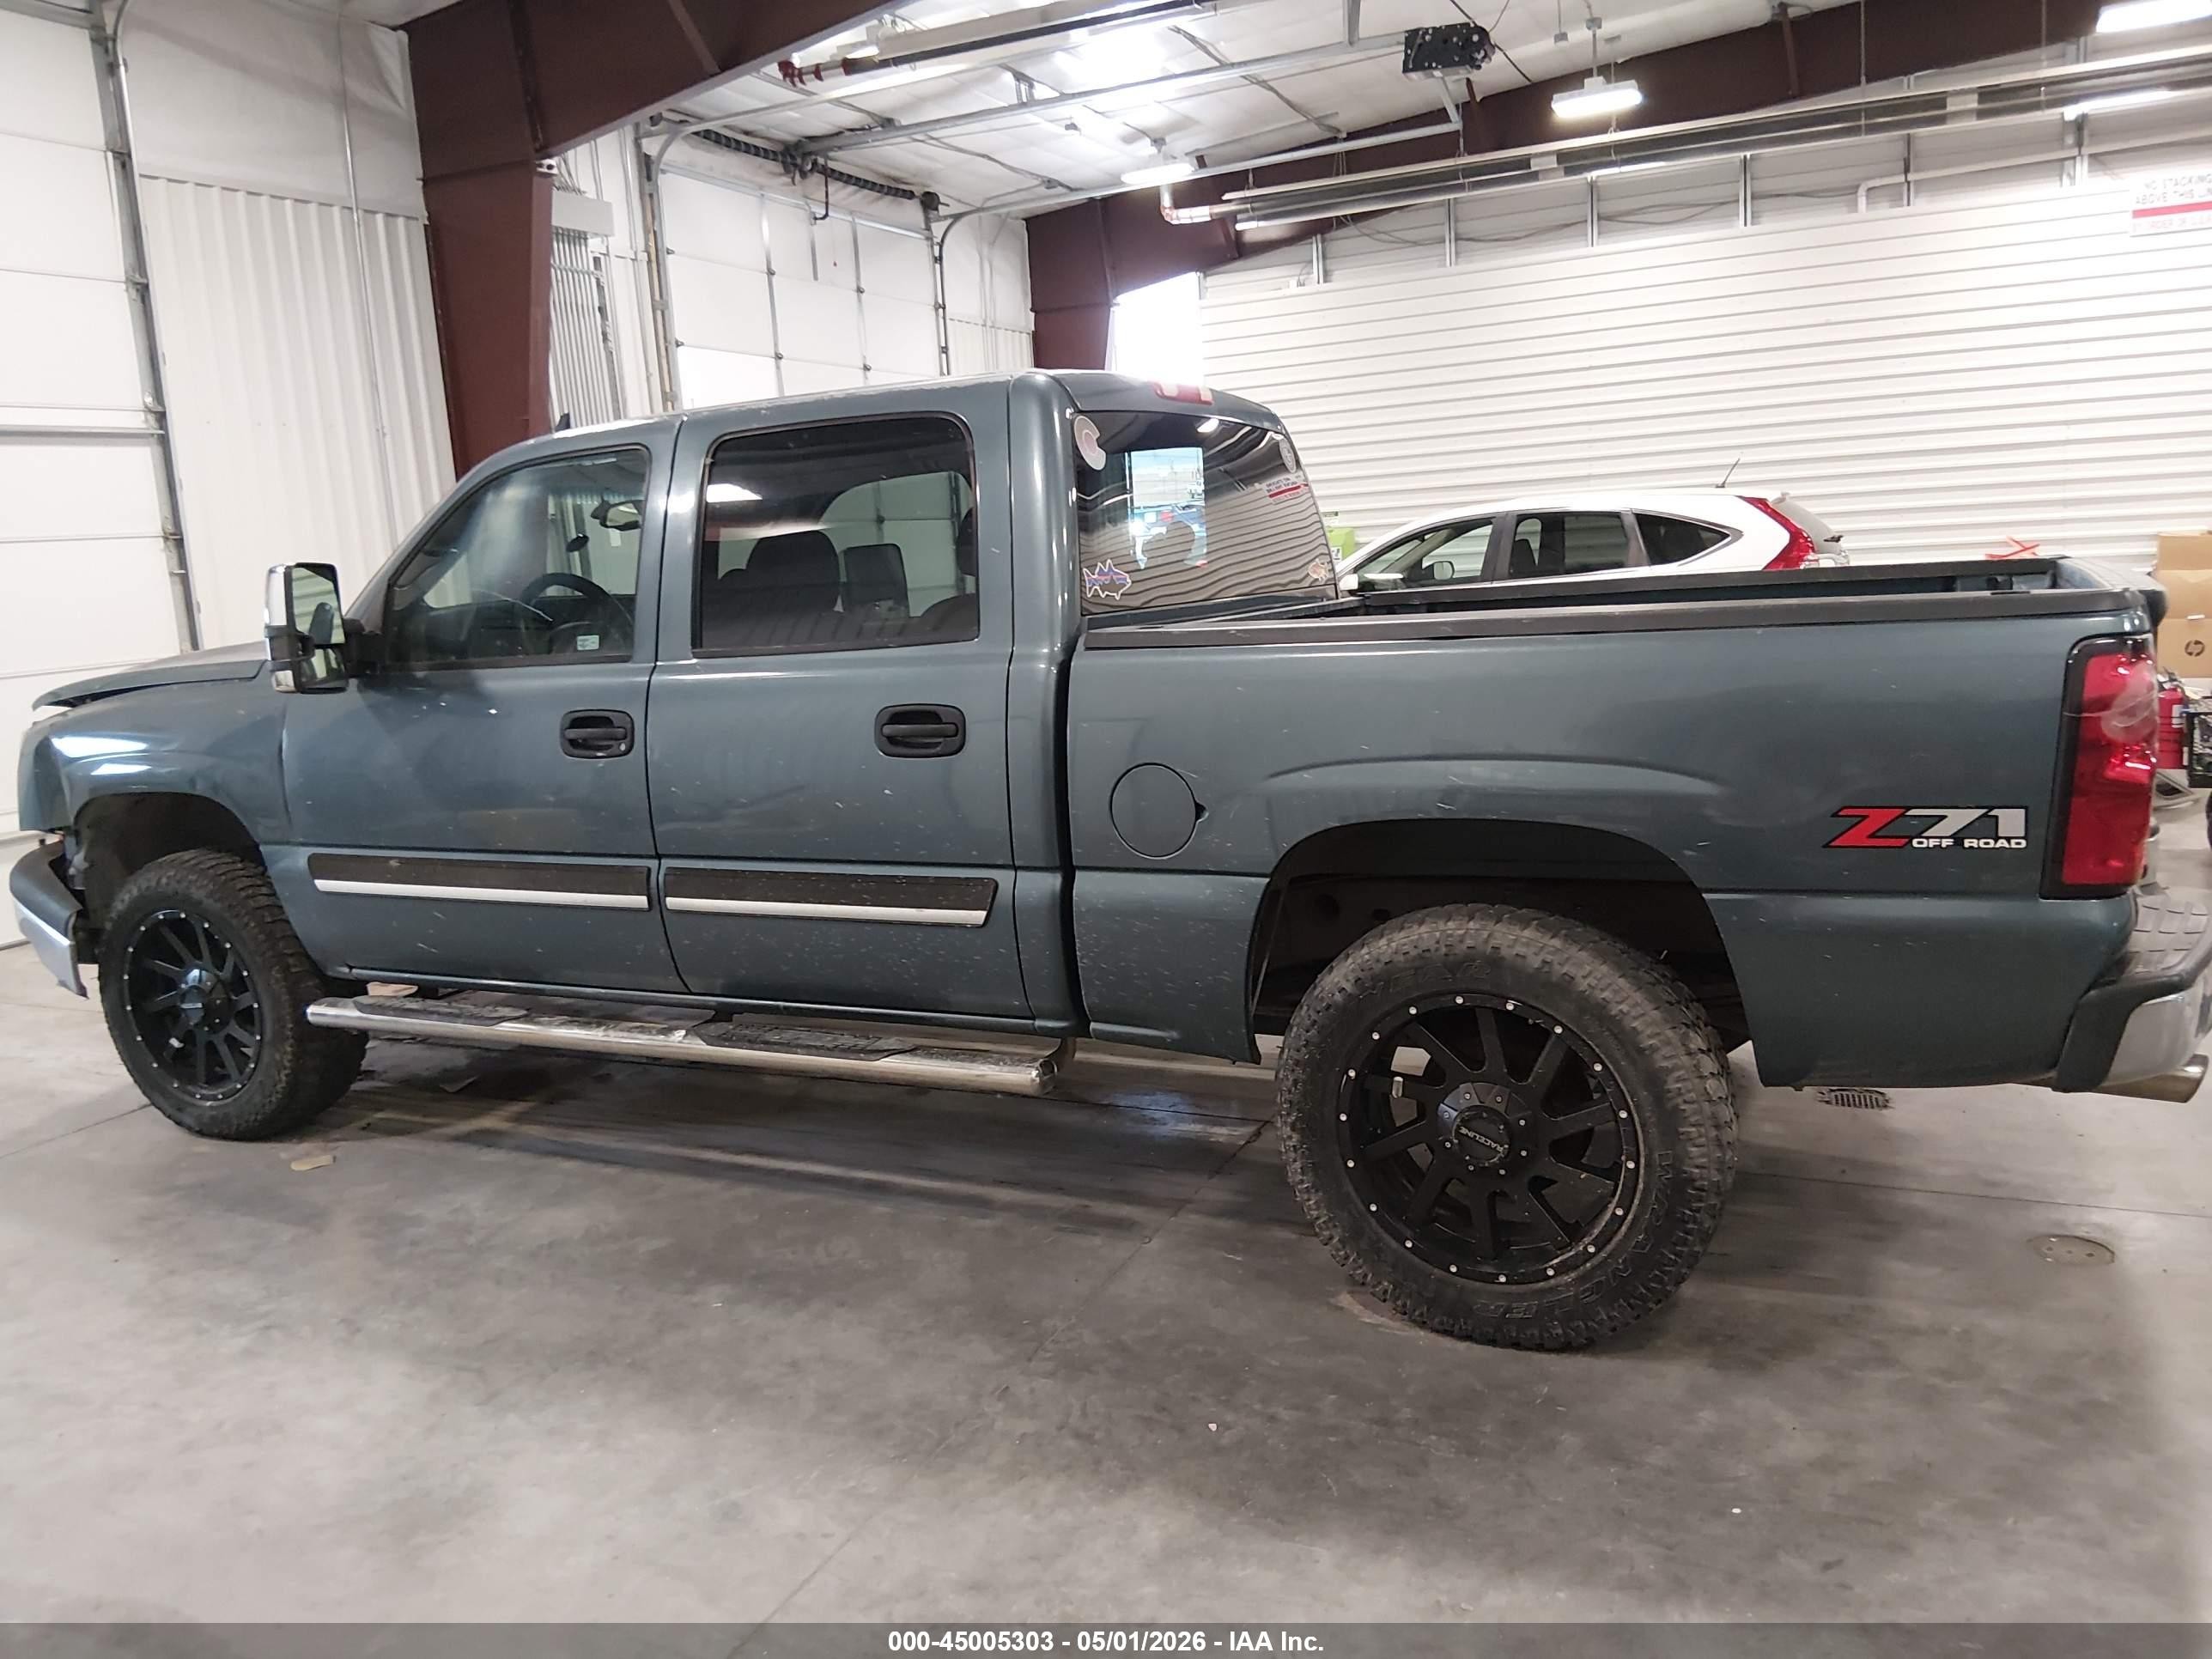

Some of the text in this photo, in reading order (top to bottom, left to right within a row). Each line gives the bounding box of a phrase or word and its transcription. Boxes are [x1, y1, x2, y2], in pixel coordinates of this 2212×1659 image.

[2136, 192, 2168, 205] ABOVE
[1823, 805, 2029, 849] Z71
[1912, 838, 2028, 849] OFF ROAD
